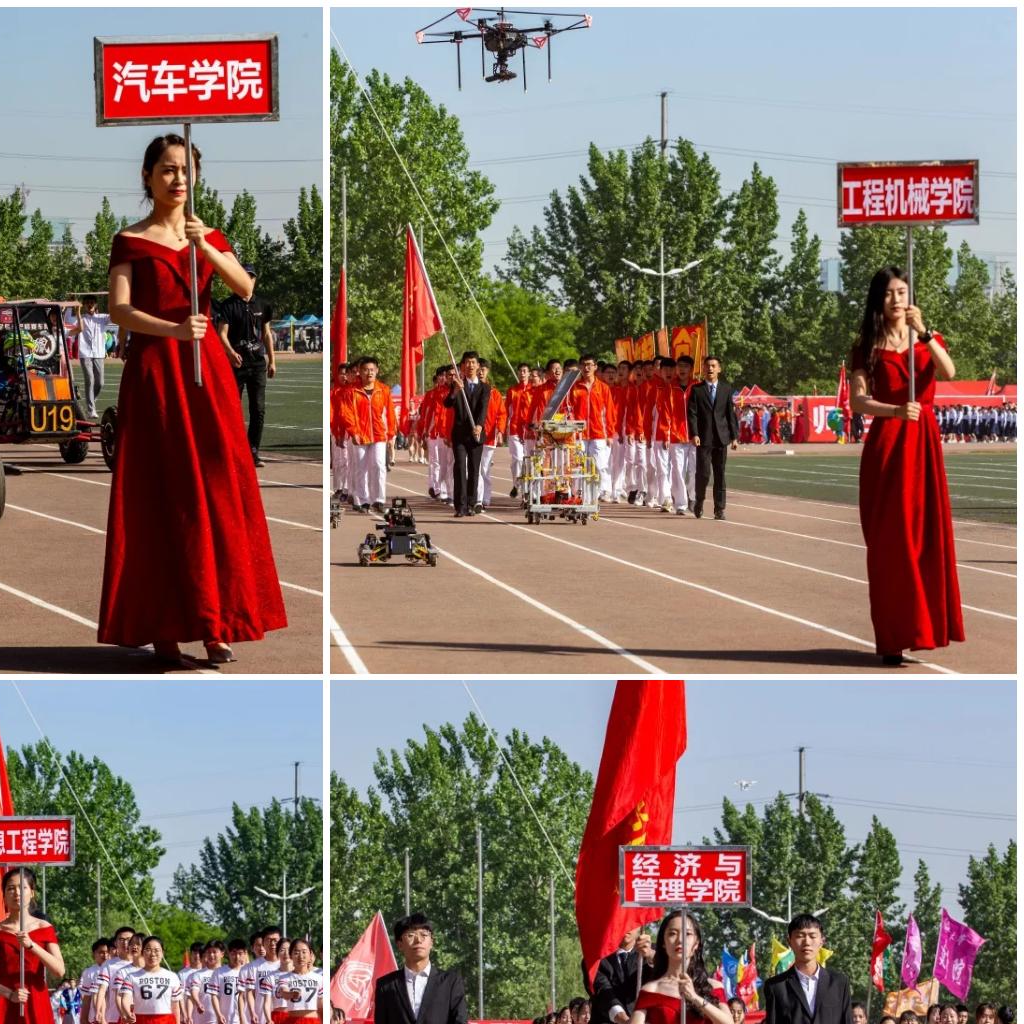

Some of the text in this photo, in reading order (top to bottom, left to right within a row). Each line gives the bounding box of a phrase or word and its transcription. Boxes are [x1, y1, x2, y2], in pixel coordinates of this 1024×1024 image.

[112, 58, 264, 103] 汽车学院
[841, 176, 974, 217] 工程机械学院
[30, 405, 74, 432] U19
[632, 853, 742, 877] 经济与
[631, 877, 741, 902] 管理学院
[139, 977, 170, 985] BOSTON
[140, 985, 168, 1000] 67
